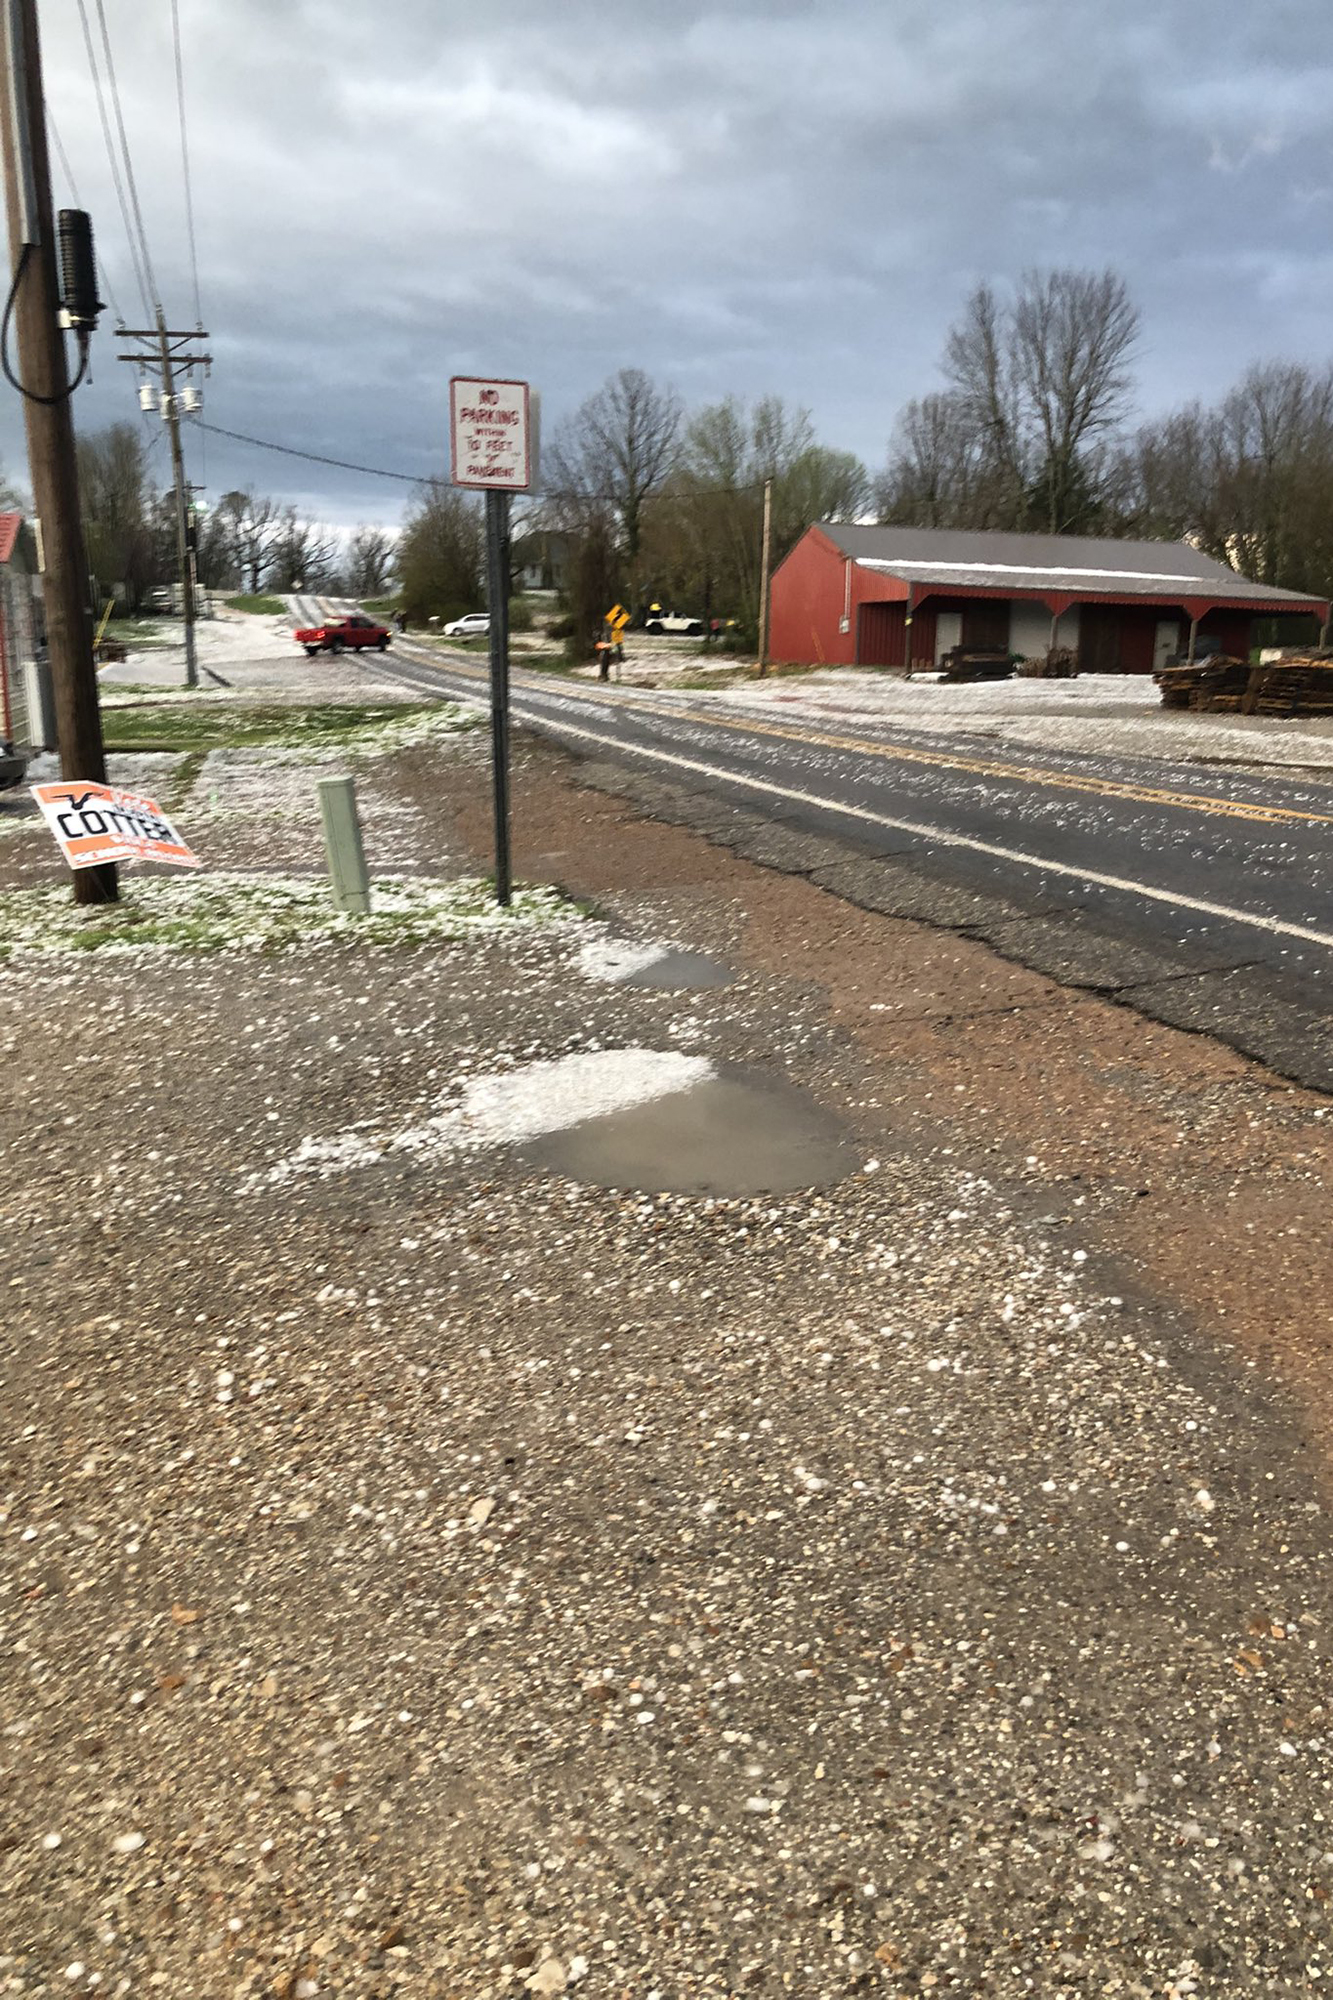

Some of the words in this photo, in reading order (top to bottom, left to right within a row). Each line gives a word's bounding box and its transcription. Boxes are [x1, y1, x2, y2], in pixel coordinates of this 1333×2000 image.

[479, 390, 499, 405] NO
[460, 407, 519, 426] PARKING
[485, 439, 513, 452] FEET
[57, 810, 178, 844] COTTER
